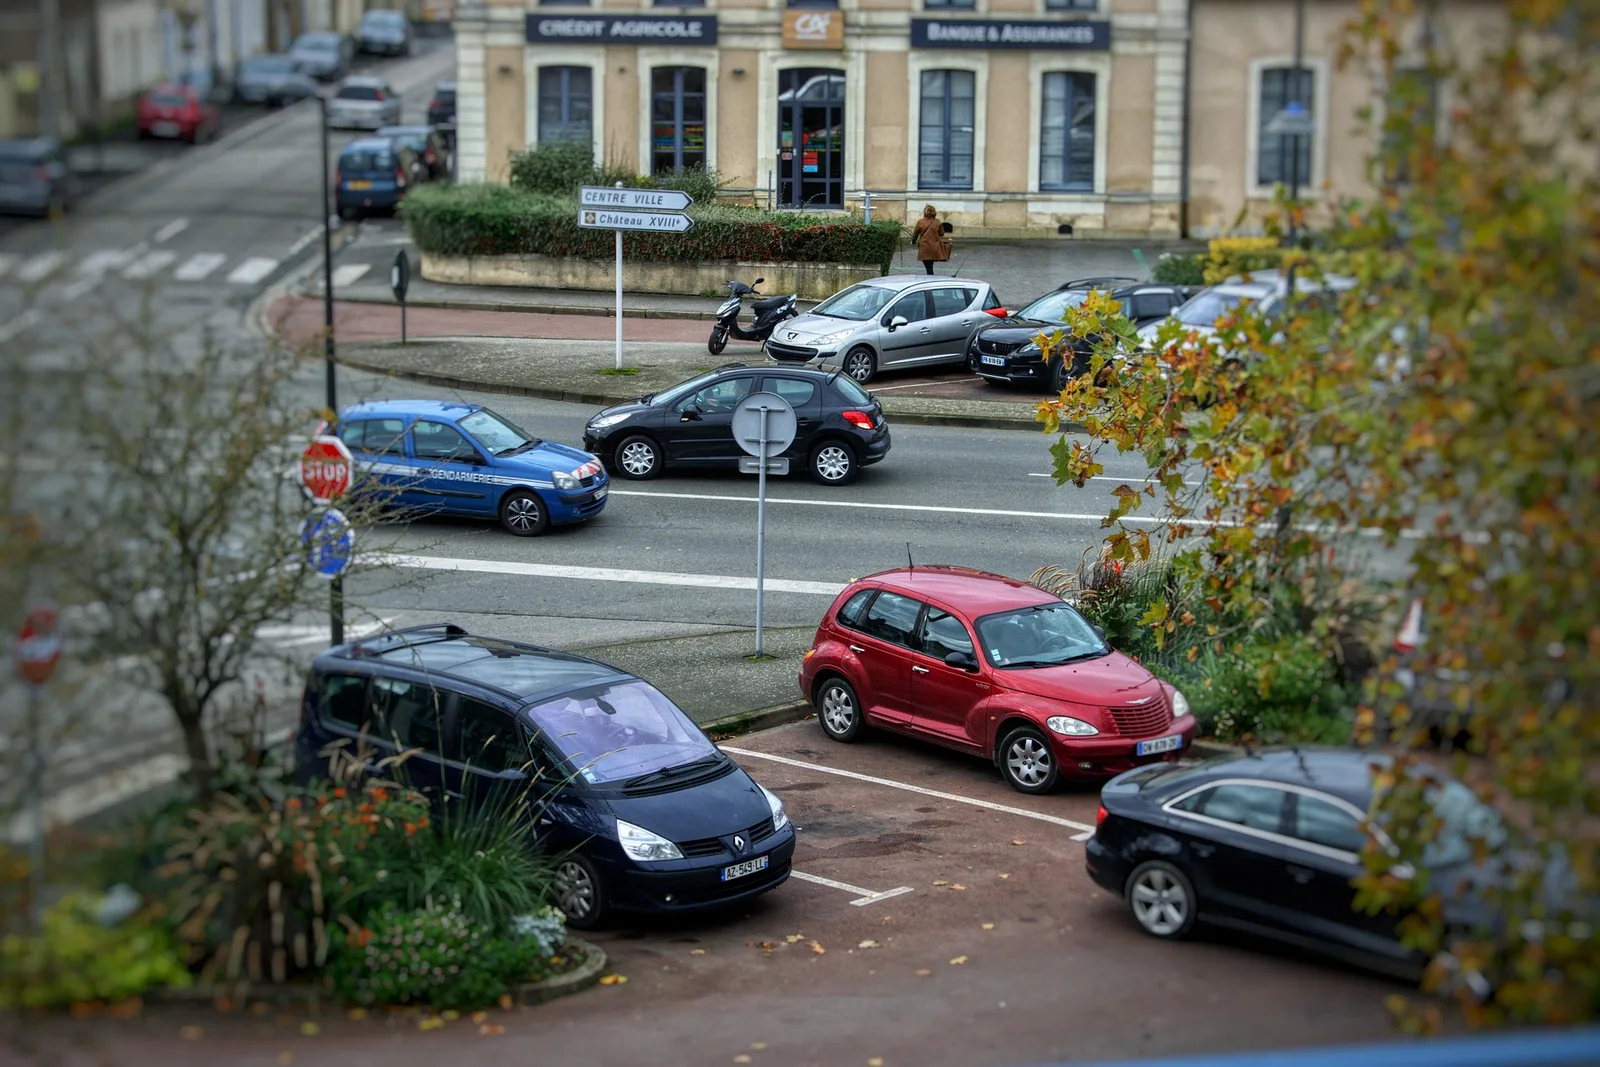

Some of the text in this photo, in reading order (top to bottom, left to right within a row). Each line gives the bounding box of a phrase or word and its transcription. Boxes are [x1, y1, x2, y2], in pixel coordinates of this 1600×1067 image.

[539, 19, 703, 37] CRÉDIT AGRICOLE
[585, 191, 663, 205] CENTRE VILLE
[599, 214, 642, 226] Château
[304, 460, 346, 482] STOP
[431, 469, 492, 484] GENDARMERIE
